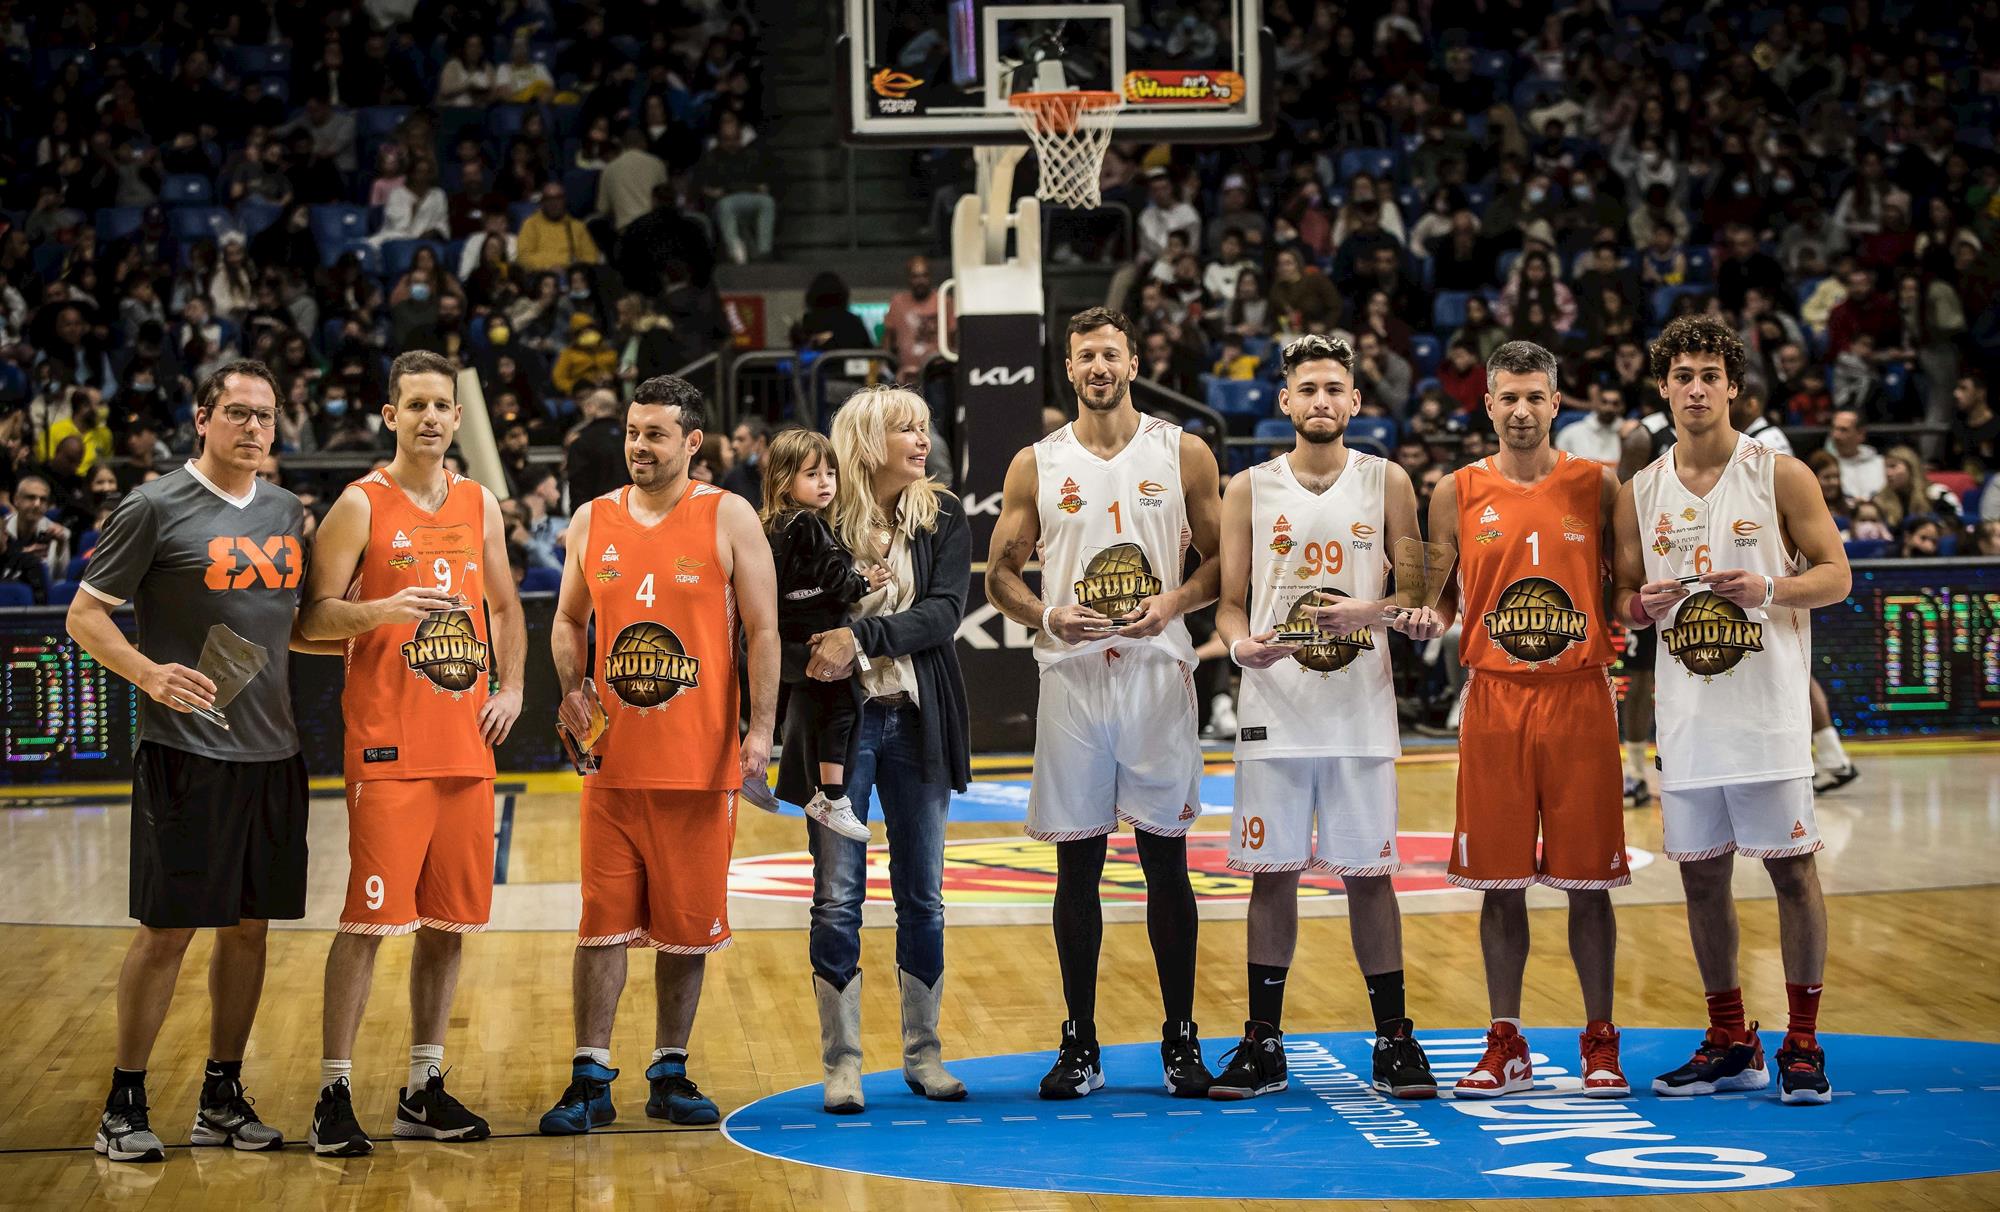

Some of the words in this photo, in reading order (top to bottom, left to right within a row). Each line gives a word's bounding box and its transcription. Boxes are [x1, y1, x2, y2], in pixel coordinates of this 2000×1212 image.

[1136, 80, 1211, 97] Winner
[969, 366, 1035, 386] KIA
[1060, 485, 1080, 495] PEAK
[1107, 501, 1121, 534] 1
[1273, 524, 1292, 533] PEAK
[1480, 514, 1500, 524] PEAK
[392, 540, 412, 549] PEAK
[1525, 531, 1539, 566] 1
[601, 554, 620, 562] PEAK
[1304, 540, 1343, 576] 99
[1695, 544, 1712, 575] 6
[433, 557, 452, 594] 9
[1075, 567, 1161, 604] אולסטאר
[635, 573, 656, 608] 4
[1485, 605, 1586, 637] אולסטאר
[1520, 635, 1546, 646] 2022
[1662, 617, 1762, 652] אולסטאר
[404, 633, 485, 667] אולסטאר
[1312, 645, 1337, 656] 2022
[1695, 649, 1720, 659] 2022
[443, 663, 466, 675] 2022
[630, 680, 655, 691] 2022
[1178, 811, 1195, 821] PEAK
[1790, 828, 1807, 840] PEAK
[1458, 832, 1469, 867] 1
[365, 875, 385, 910] 9
[1293, 1072, 1405, 1119] הסתדרות
[1348, 1119, 1441, 1149] מבית
